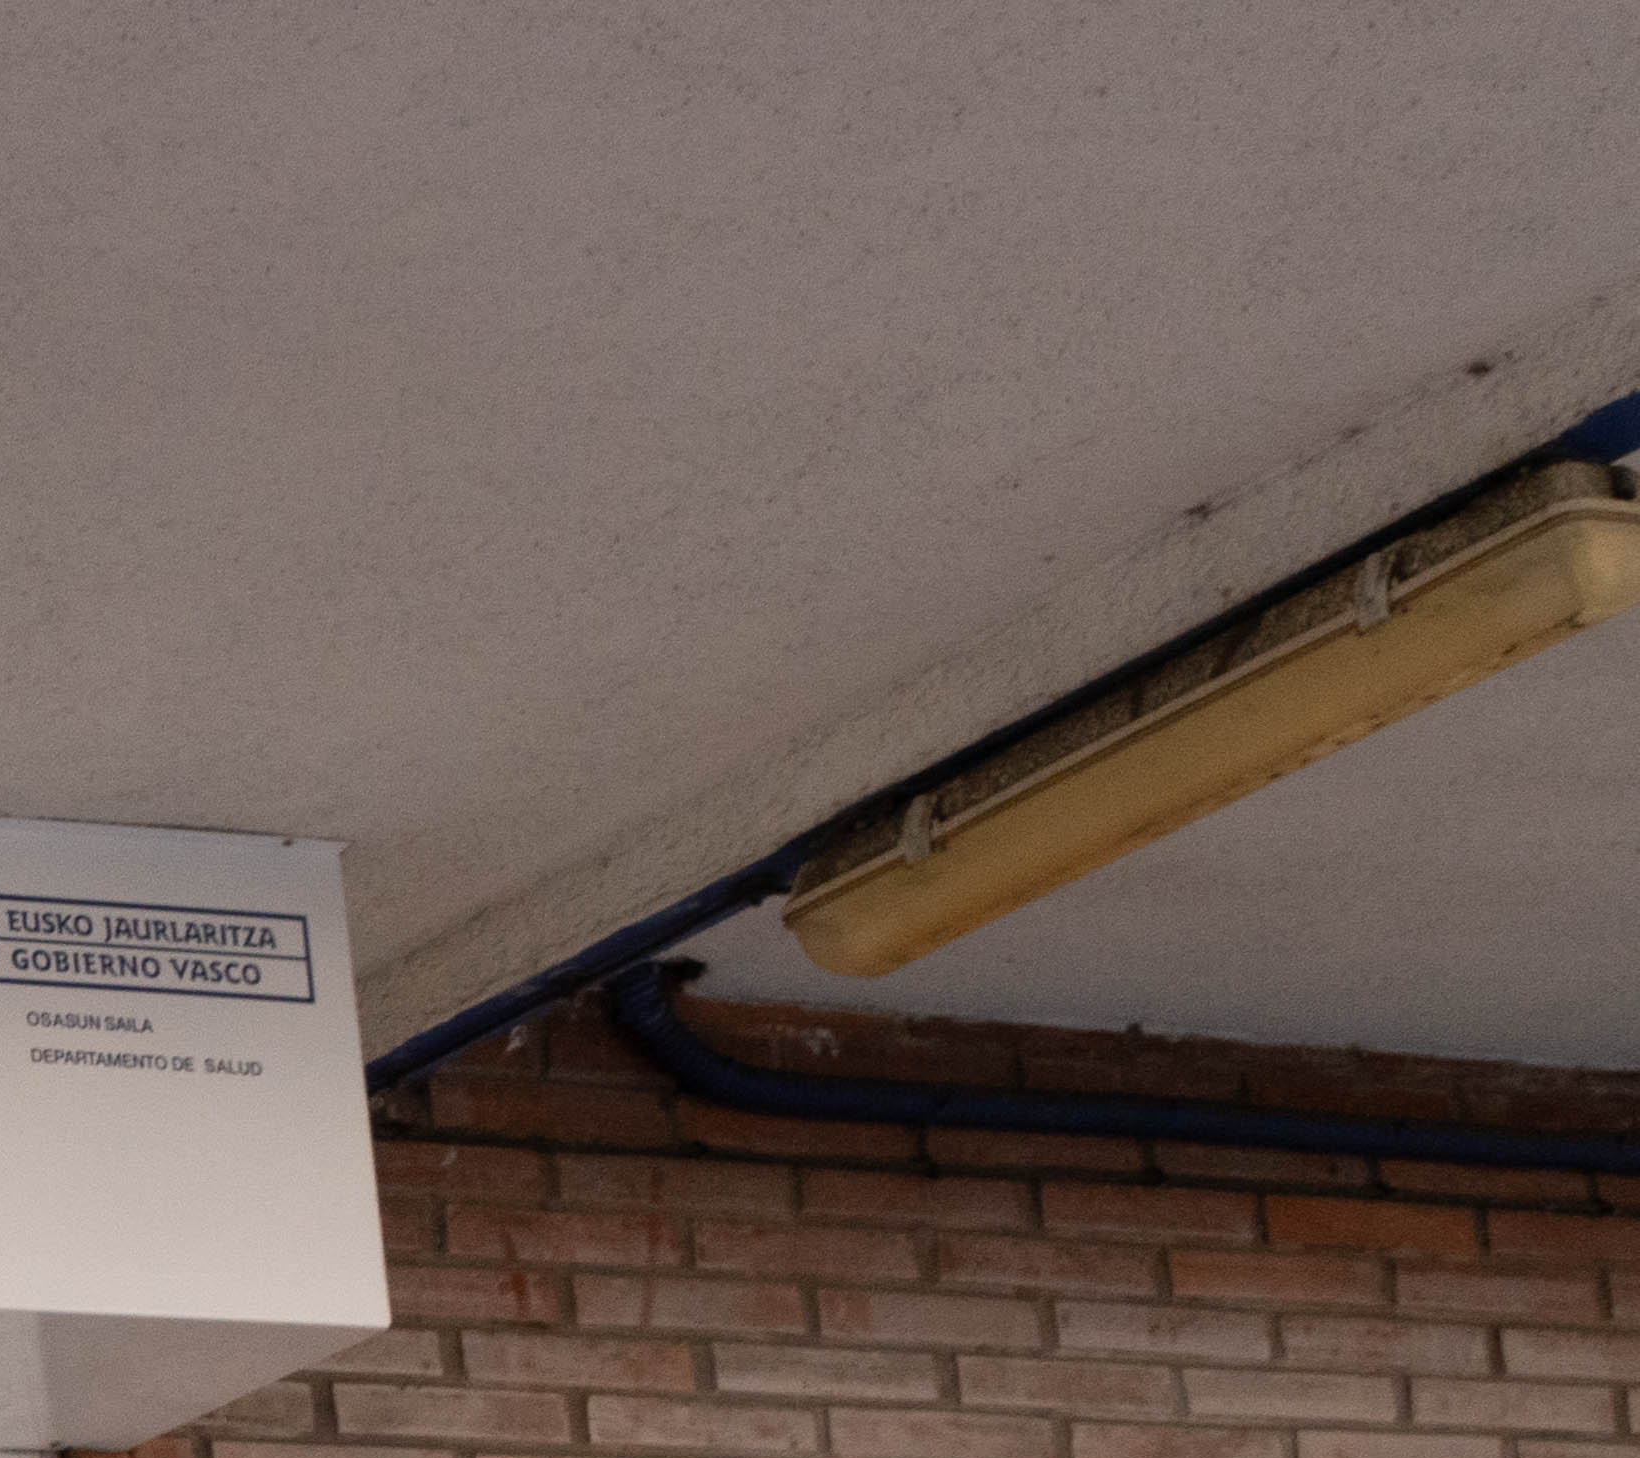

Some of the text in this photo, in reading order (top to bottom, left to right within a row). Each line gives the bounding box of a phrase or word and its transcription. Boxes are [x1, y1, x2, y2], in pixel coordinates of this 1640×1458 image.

[7, 909, 277, 950] EUSKO JAURLARITZA
[11, 948, 262, 986] GOBIERNO VASCO
[27, 1011, 154, 1034] OSASUN SAILA
[30, 1048, 264, 1077] DEPARTAMENTO DE SALUD
